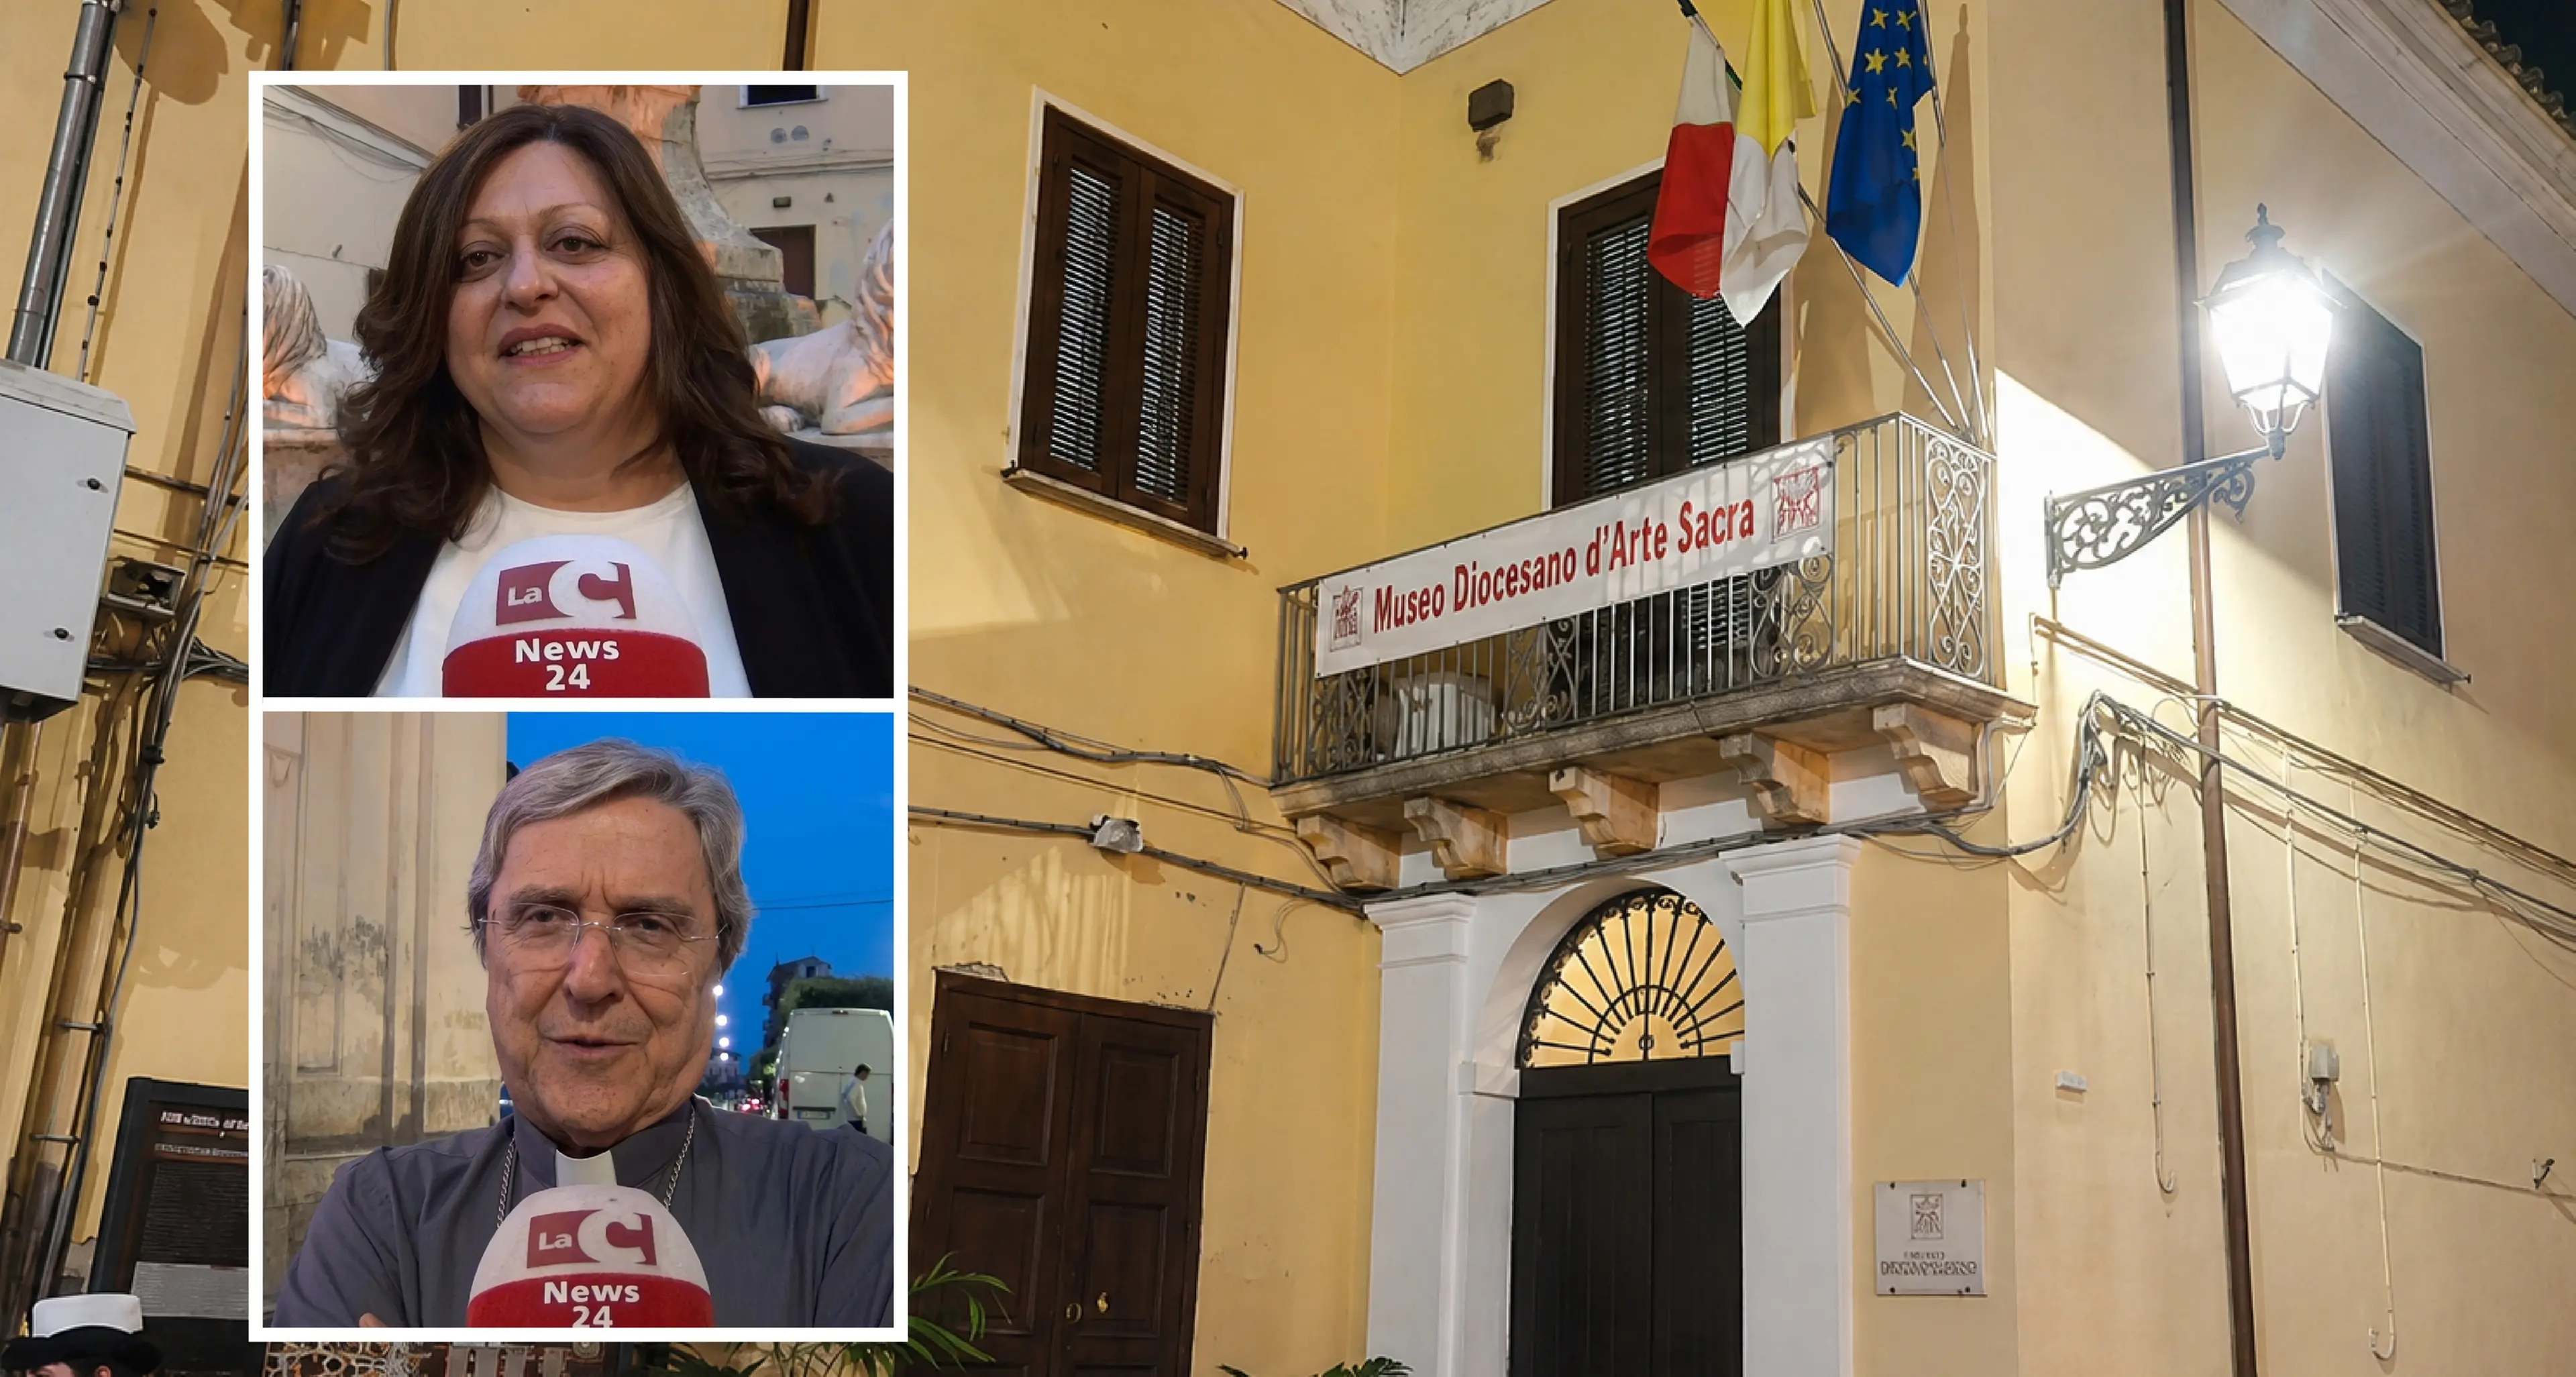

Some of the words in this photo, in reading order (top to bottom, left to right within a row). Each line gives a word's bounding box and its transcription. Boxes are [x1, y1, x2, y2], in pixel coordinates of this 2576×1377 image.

[1374, 584, 1444, 632] Museo
[1454, 547, 1576, 613] Diocesano
[1677, 499, 1755, 554] Sacra
[515, 638, 620, 663] News
[545, 663, 590, 692] 24
[544, 1281, 640, 1304] News
[572, 1305, 613, 1328] 24
